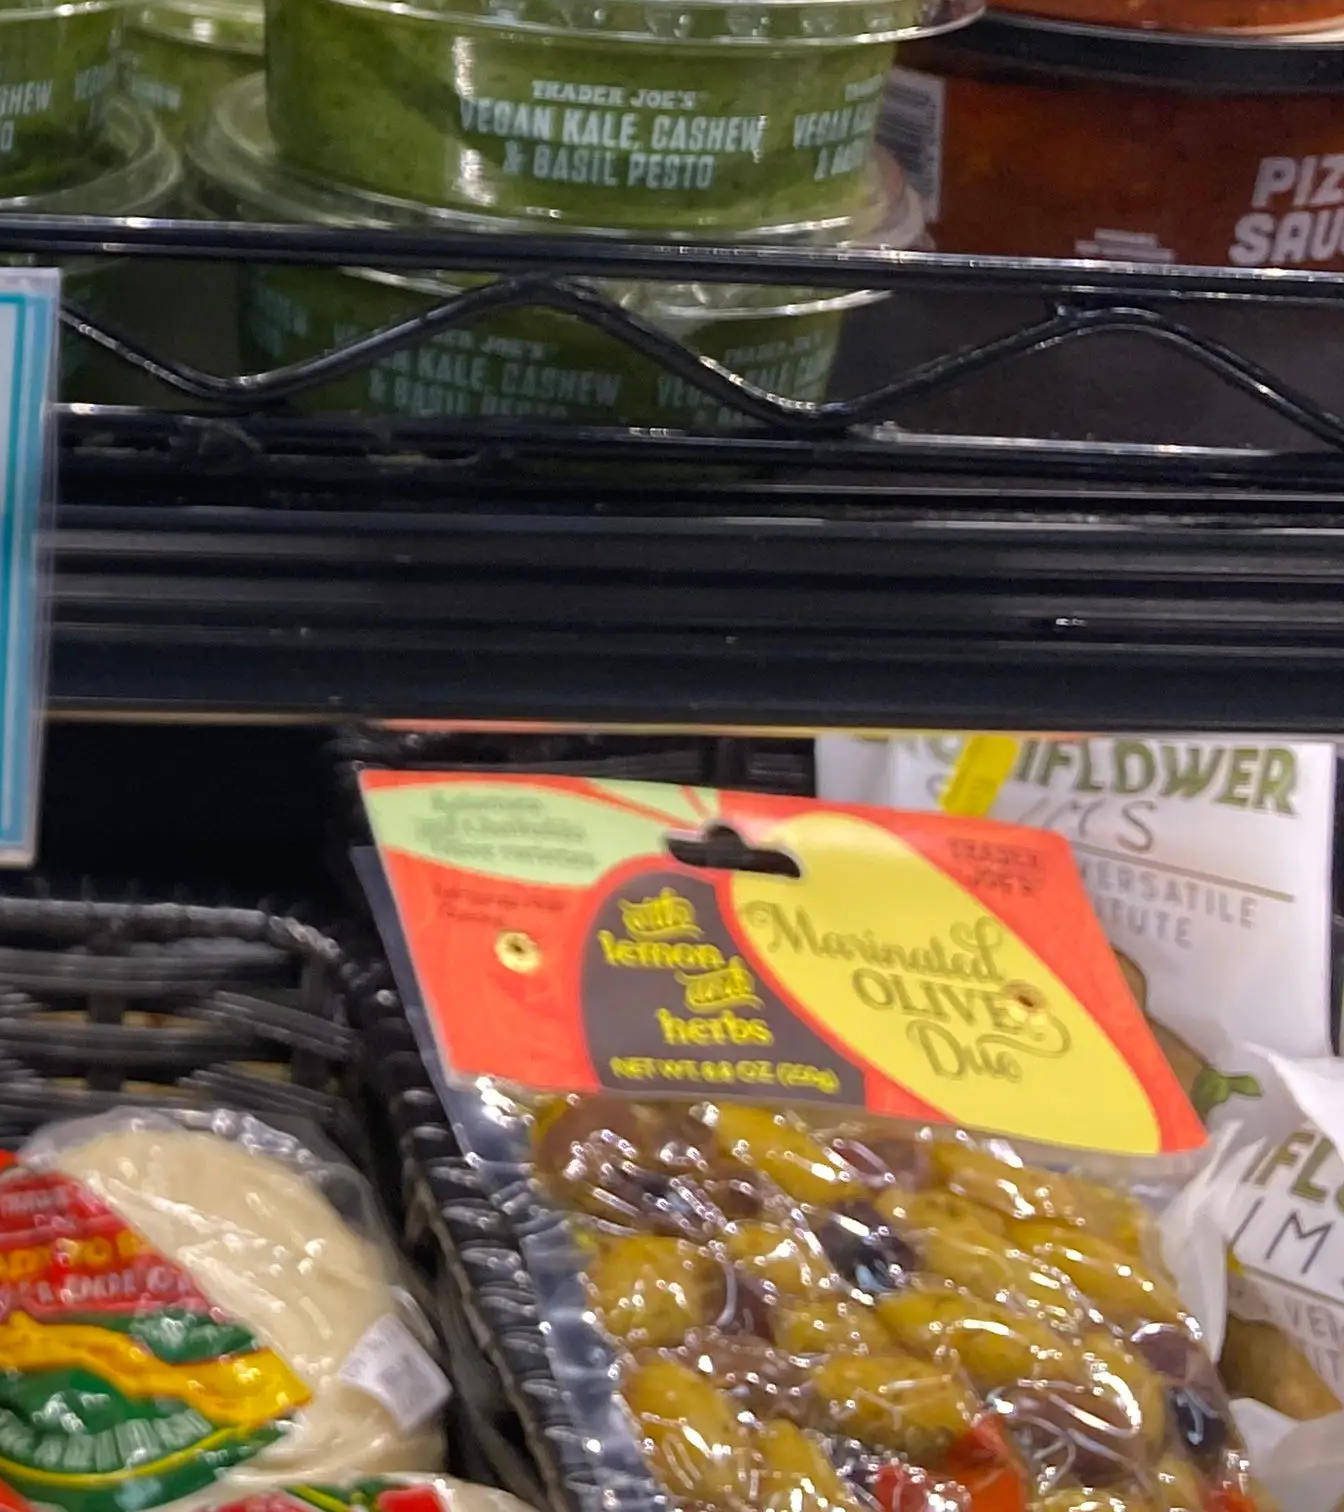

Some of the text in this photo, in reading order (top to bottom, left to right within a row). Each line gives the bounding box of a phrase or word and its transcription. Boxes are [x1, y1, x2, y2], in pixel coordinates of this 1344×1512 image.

[532, 80, 623, 108] TRADER
[460, 98, 551, 141] VEGAN
[653, 116, 764, 152] CASHEW
[533, 145, 618, 187] BASIL
[628, 153, 713, 189] PESTO
[597, 930, 724, 969] lemon
[654, 1008, 774, 1046] herbs
